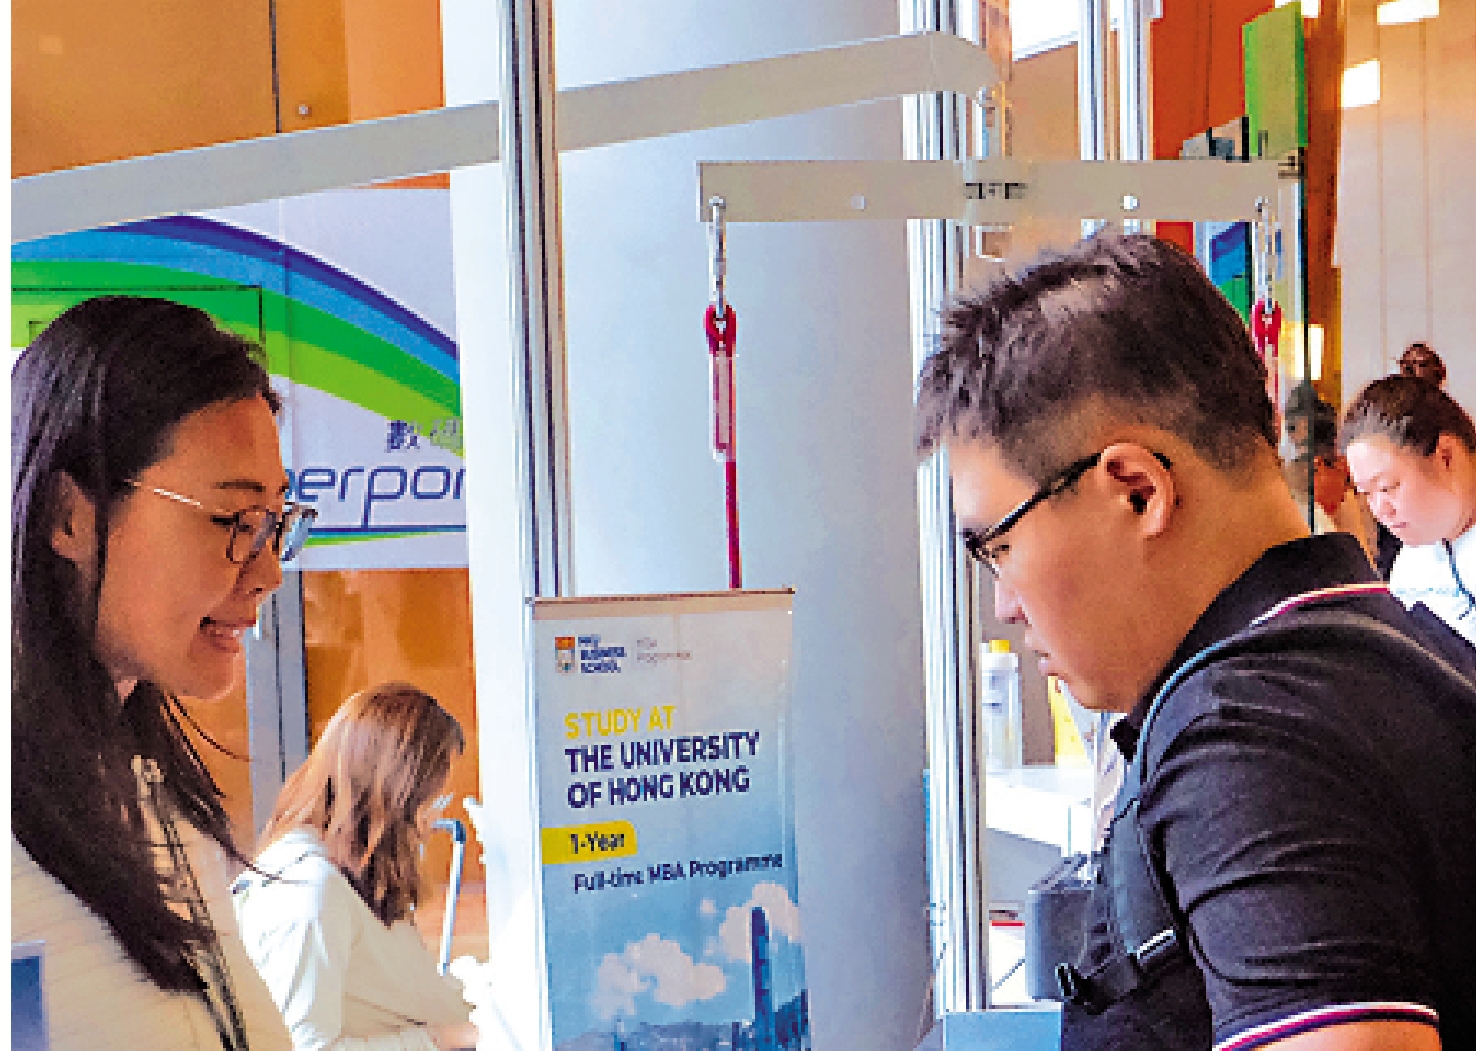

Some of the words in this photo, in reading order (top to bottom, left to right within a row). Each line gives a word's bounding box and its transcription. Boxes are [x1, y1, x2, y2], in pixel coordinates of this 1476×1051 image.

[564, 707, 641, 740] STUDY
[648, 705, 677, 731] AT
[565, 744, 614, 773] THE
[620, 729, 760, 769] UNIVERSITY
[567, 781, 602, 809] OF
[608, 774, 673, 806] HONG
[680, 765, 750, 798] KONG
[570, 831, 625, 854] 1-Year
[574, 867, 645, 894] Full-time
[647, 861, 686, 882] MBA
[689, 854, 783, 879] Programme
